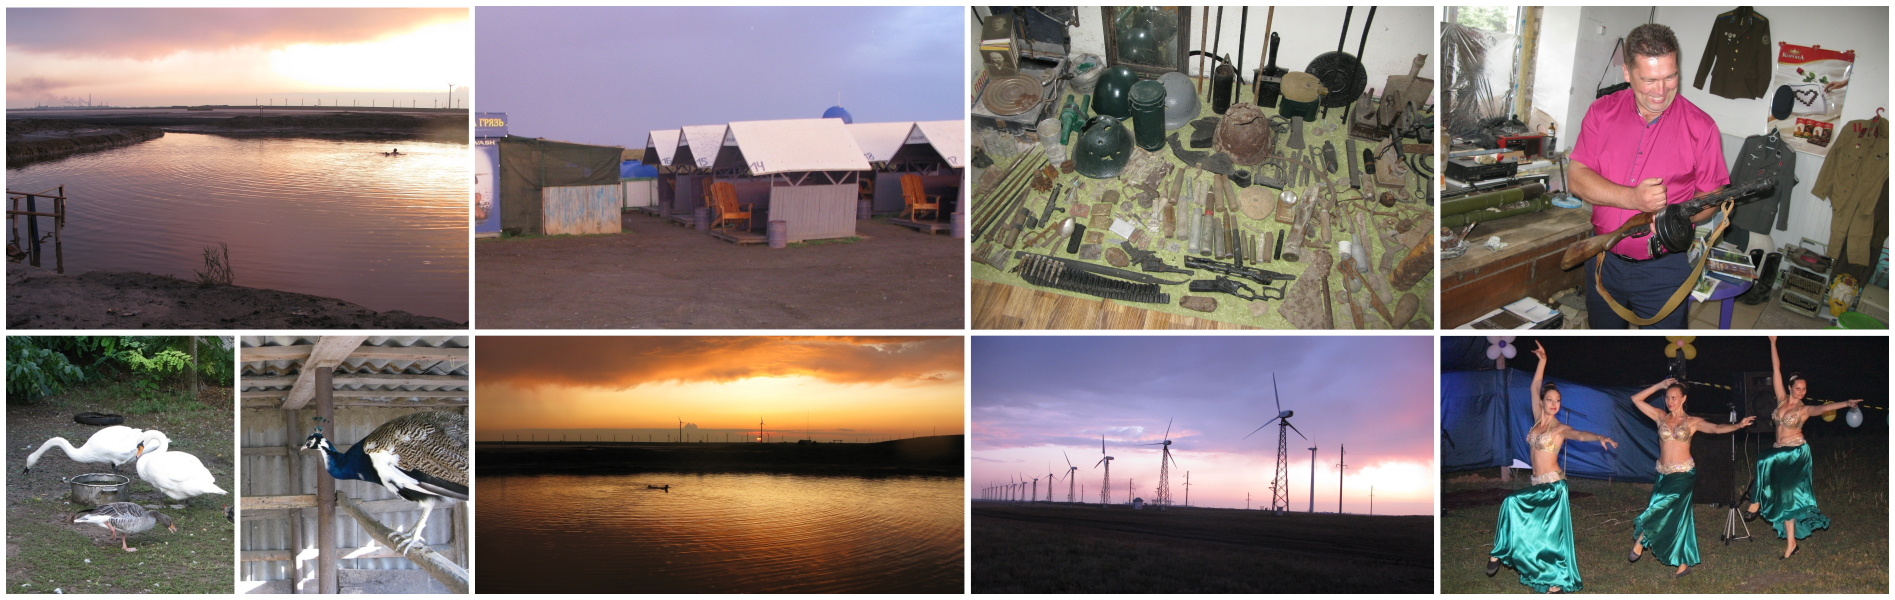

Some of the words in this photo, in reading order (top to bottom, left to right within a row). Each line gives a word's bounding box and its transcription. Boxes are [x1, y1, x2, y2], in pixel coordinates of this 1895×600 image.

[479, 118, 504, 127] ГРЯЗЬ
[697, 157, 708, 166] 15
[948, 156, 957, 165] 17
[751, 161, 765, 172] 14
